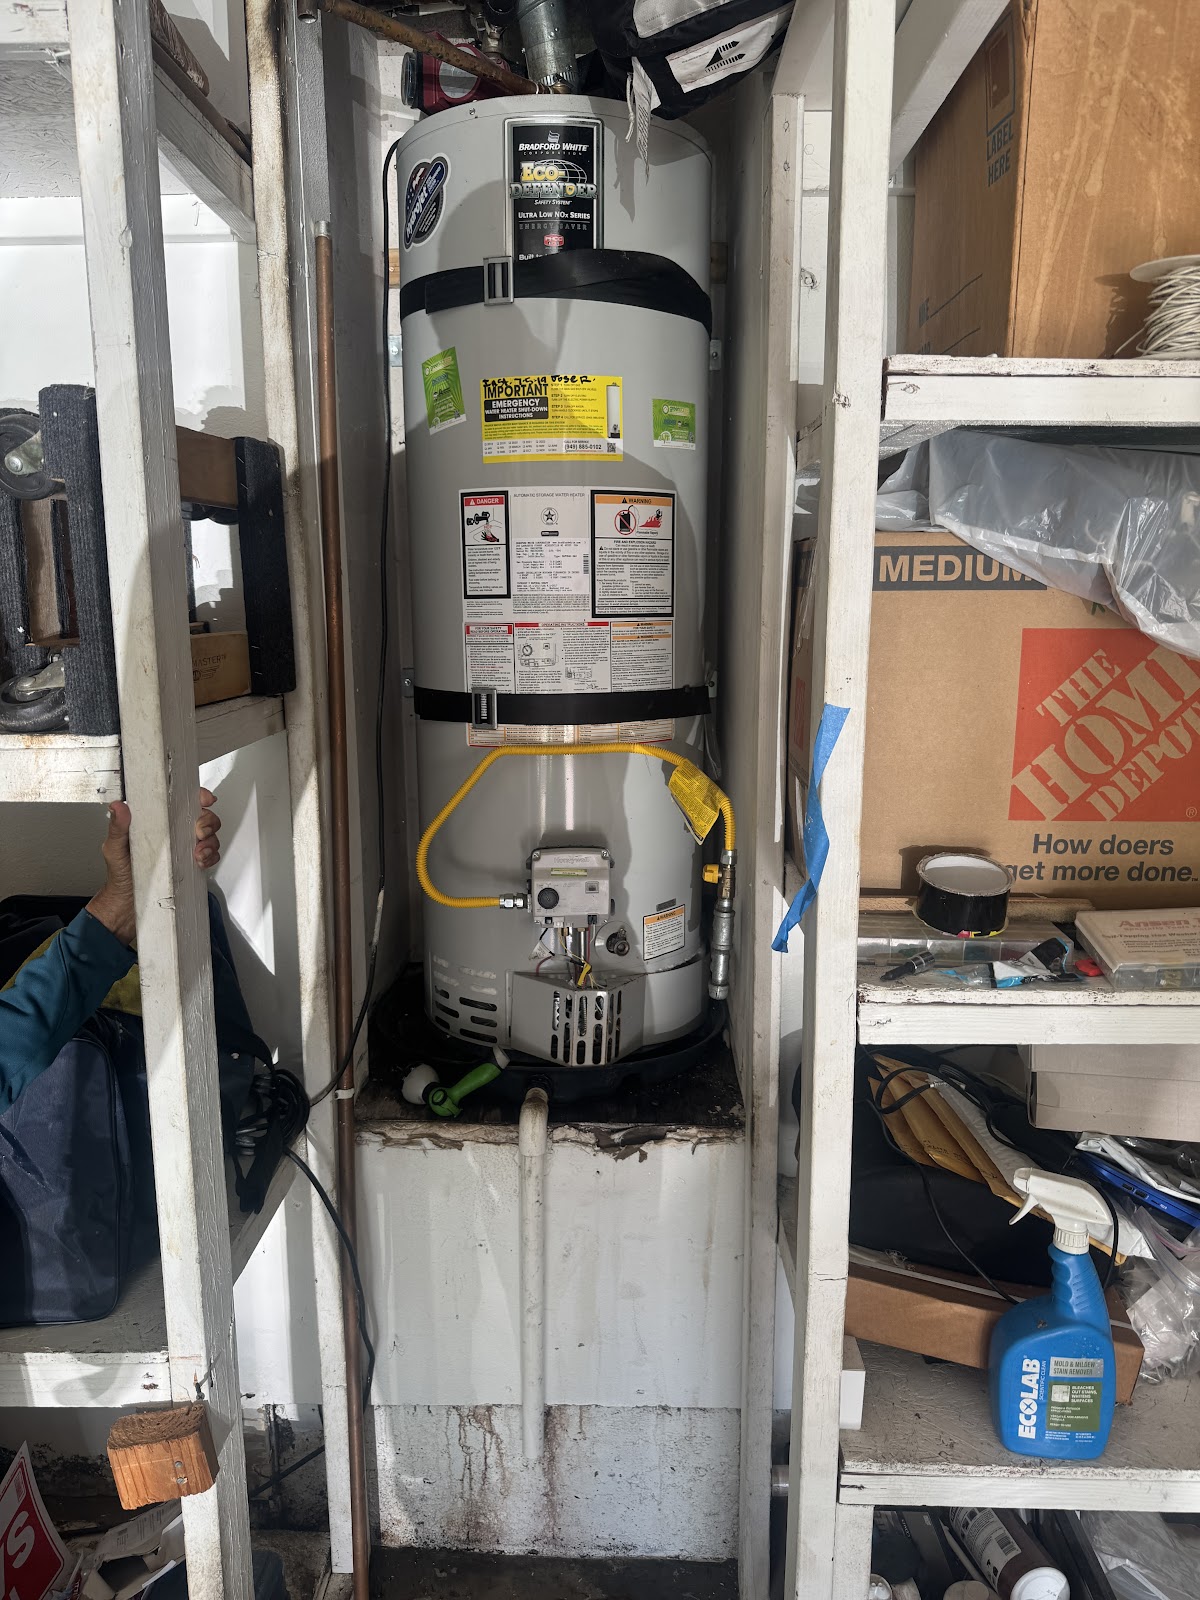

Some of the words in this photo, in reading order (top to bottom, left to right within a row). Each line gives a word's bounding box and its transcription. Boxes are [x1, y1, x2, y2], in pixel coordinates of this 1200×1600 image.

[519, 143, 560, 151] BRADFORD
[562, 143, 588, 152] WHITE
[986, 119, 1014, 161] LABEL
[988, 148, 1011, 187] HERE
[510, 182, 598, 198] DEFENDER
[483, 383, 548, 399] IMPORTANT
[492, 398, 540, 408] EMERGENCY
[1035, 648, 1122, 727] THE
[1032, 834, 1092, 854] How
[1099, 834, 1175, 855] doers
[1052, 864, 1120, 881] more
[660, 910, 676, 919] WARNING
[1018, 1358, 1041, 1439] ECOLAB
